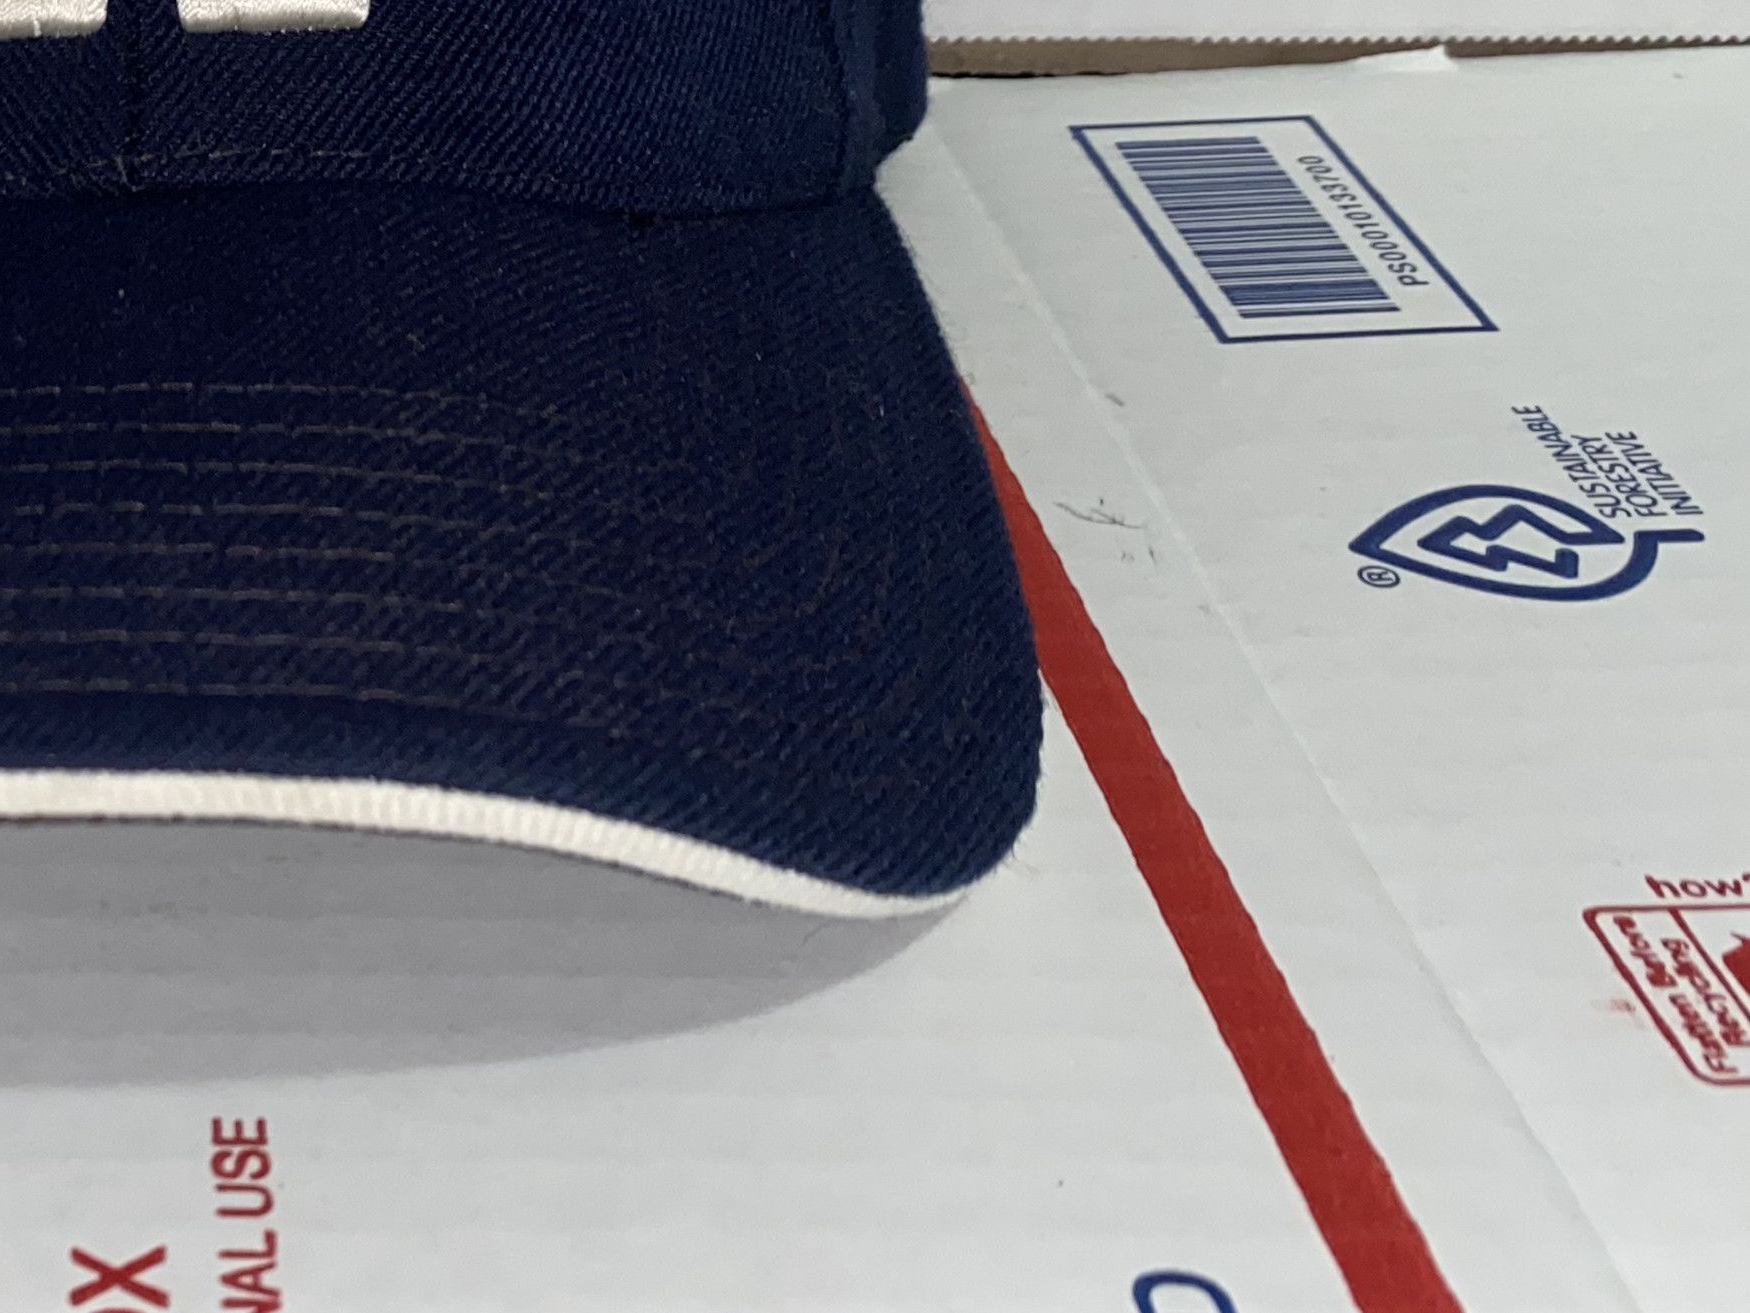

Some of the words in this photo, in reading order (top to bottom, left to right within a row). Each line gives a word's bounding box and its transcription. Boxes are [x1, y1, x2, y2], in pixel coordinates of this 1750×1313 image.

[1296, 155, 1430, 287] PS00010133700
[1510, 404, 1632, 520] SUSTAINABLE
[1570, 433, 1669, 519] FORESTRY
[1604, 430, 1704, 517] INITIATIVE
[209, 1115, 274, 1218] USE
